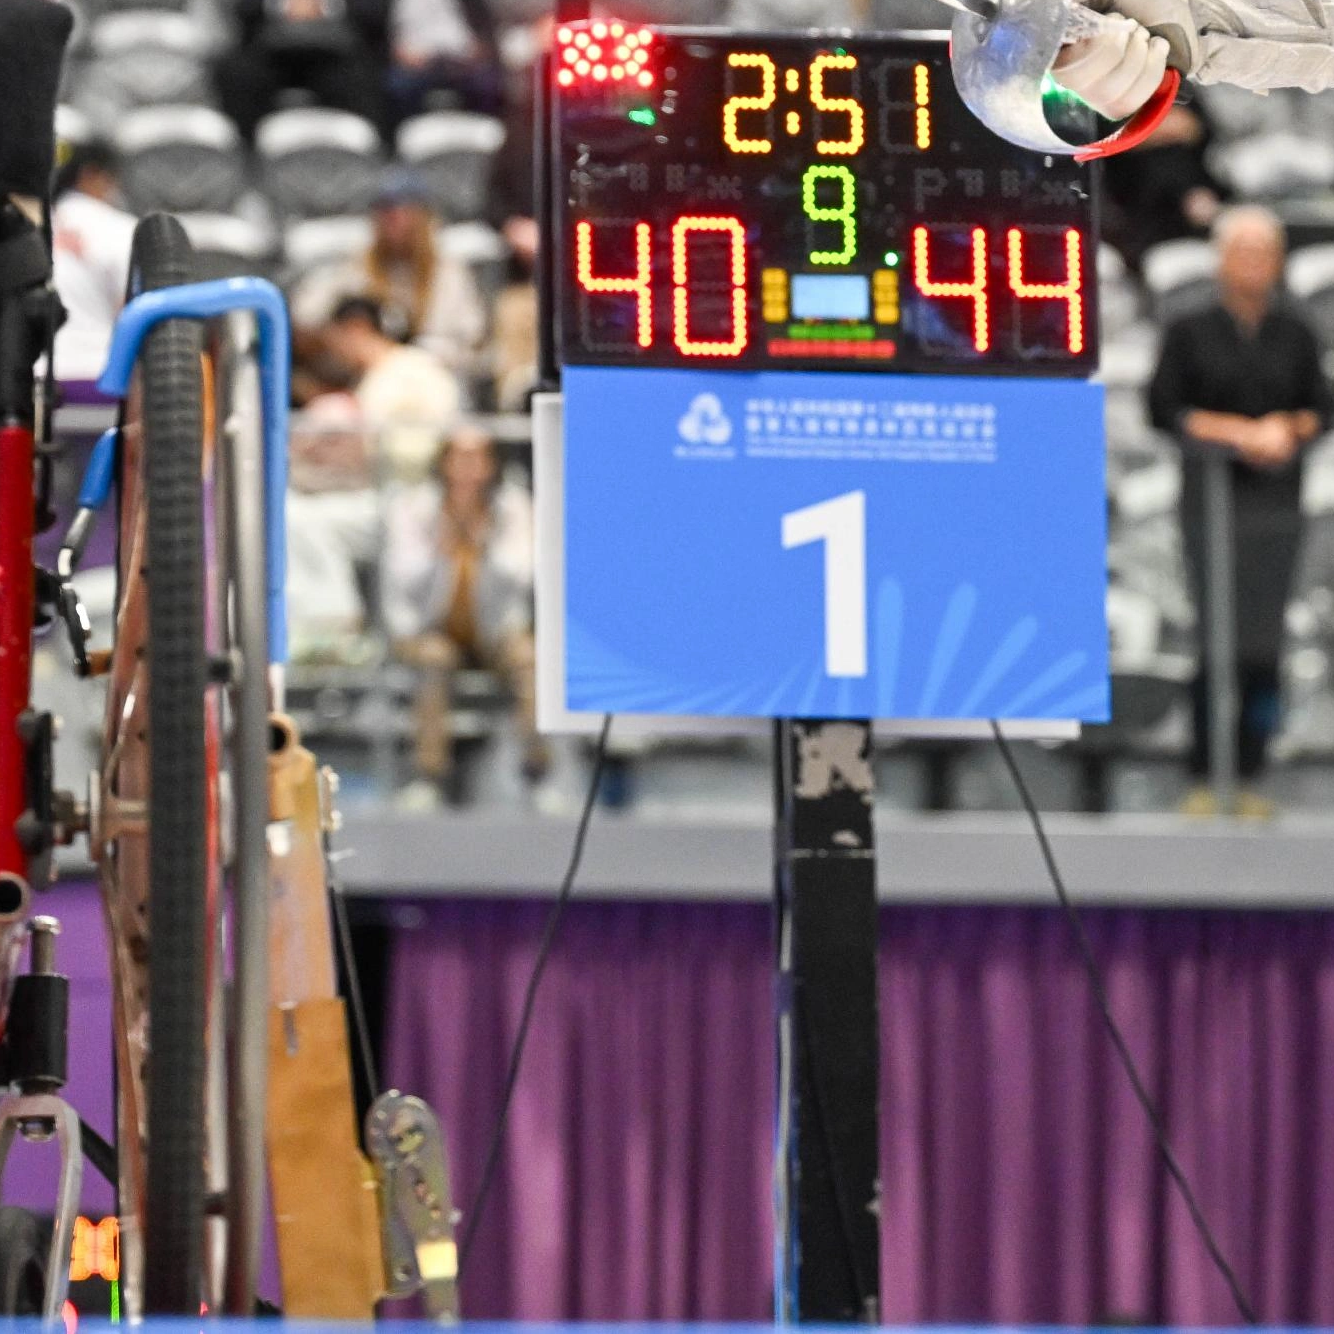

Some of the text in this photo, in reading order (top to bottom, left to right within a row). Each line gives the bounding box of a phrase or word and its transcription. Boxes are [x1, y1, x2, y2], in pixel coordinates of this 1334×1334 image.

[722, 53, 931, 155] 2:51
[802, 164, 857, 265] 9
[576, 215, 748, 357] 40
[913, 225, 1082, 354] 44
[781, 490, 867, 678] 1
